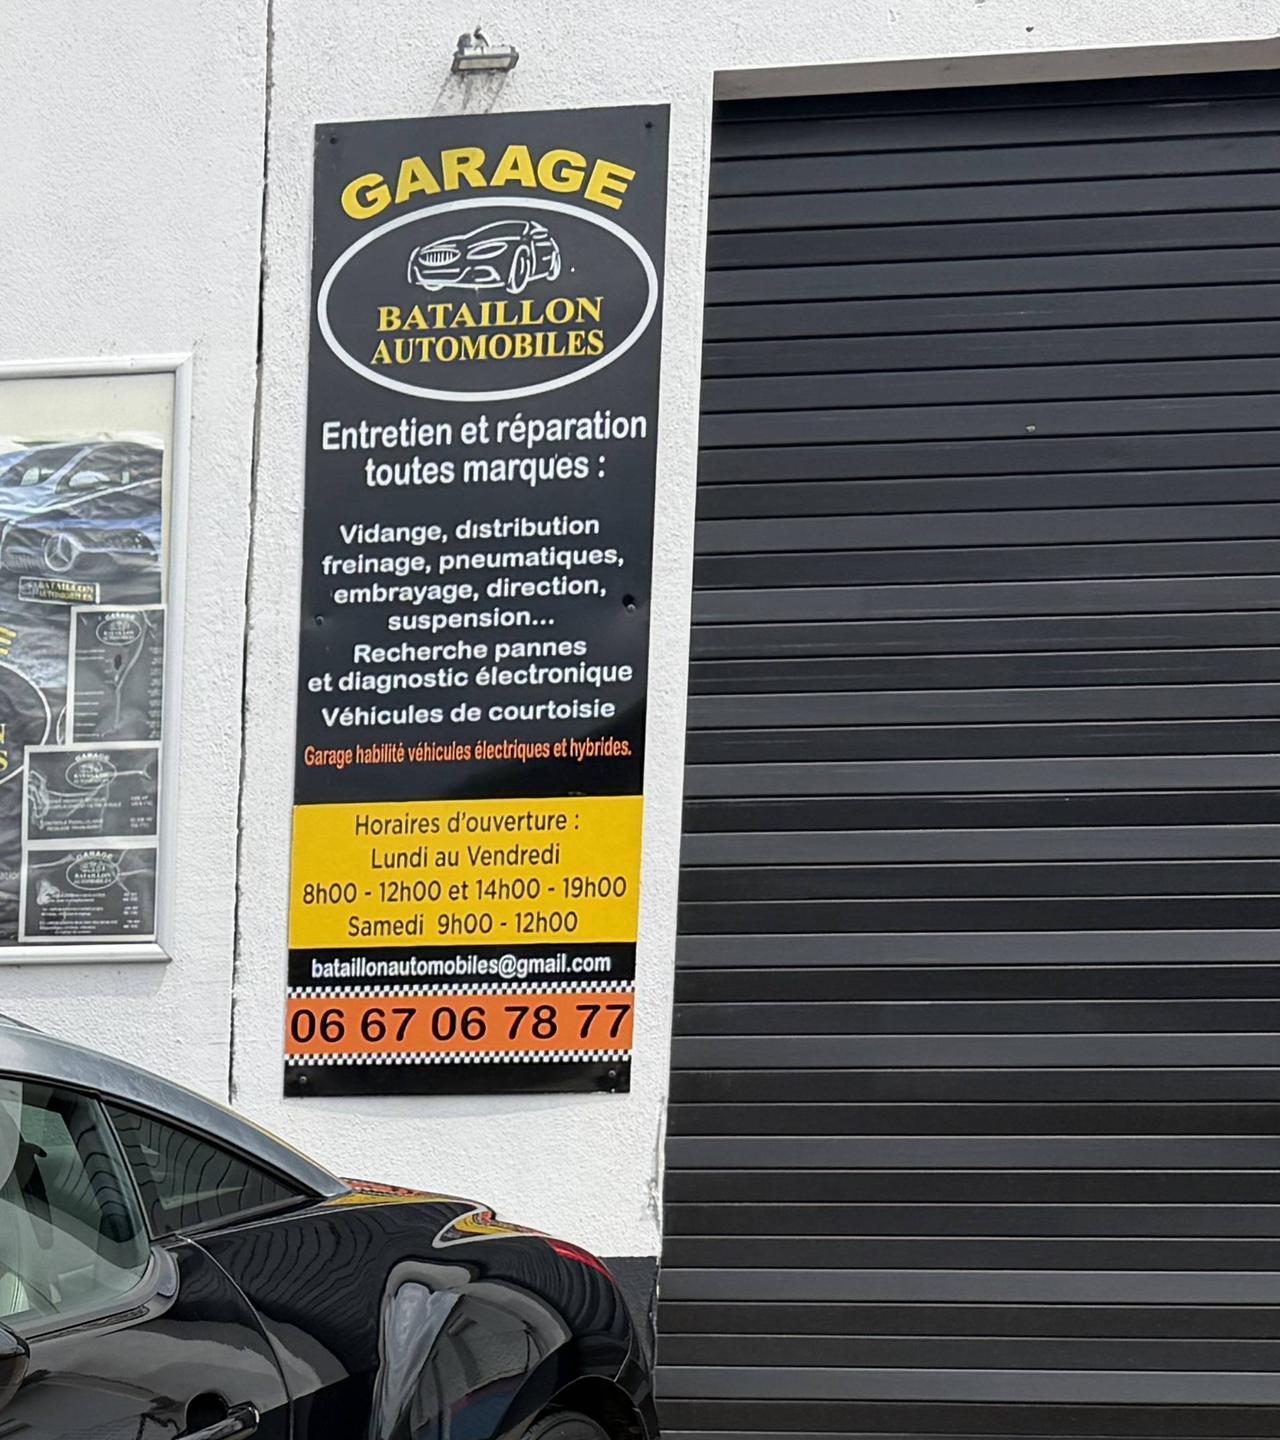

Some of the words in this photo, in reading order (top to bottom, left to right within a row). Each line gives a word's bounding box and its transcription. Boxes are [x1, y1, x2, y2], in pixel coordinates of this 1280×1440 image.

[341, 144, 636, 220] GARAGE
[377, 296, 605, 332] BATAILLON
[370, 329, 605, 365] AUTOMOBILES
[322, 419, 452, 451] Entretien
[461, 415, 489, 445] et
[497, 411, 647, 449] réparation
[365, 457, 454, 487] toutes
[464, 453, 589, 489] marques
[598, 455, 606, 477] :
[339, 523, 448, 546] Vidange,
[455, 516, 600, 541] distribution
[322, 554, 432, 577] freinage,
[439, 546, 625, 575] pneumatiques,
[333, 582, 479, 607] embrayage,
[486, 576, 607, 599] direction,
[387, 608, 555, 633] suspension...
[353, 640, 487, 664] Recherche
[495, 638, 588, 660] pannes
[307, 673, 333, 693] et
[338, 665, 469, 694] diagnostic
[475, 662, 633, 690] électronique
[321, 703, 443, 728] Véhicules
[450, 701, 482, 723] de
[488, 698, 616, 721] courtoisie
[304, 745, 353, 769] Garage
[356, 742, 405, 764] habilité
[408, 740, 471, 763] véhicules
[474, 738, 550, 762] électriques
[553, 738, 567, 757] et
[570, 736, 632, 763] hybrides.
[355, 813, 440, 837] Horaires
[371, 846, 428, 869] Lundi
[434, 850, 460, 867] au
[466, 843, 560, 866] Vendredi
[302, 882, 357, 905] 8h00
[379, 880, 441, 903] 12h00
[448, 882, 469, 901] et
[475, 877, 541, 900] 14h00
[562, 876, 627, 898] 19h00
[348, 914, 424, 937] Samedi
[437, 913, 493, 935] 9h00
[514, 911, 578, 933] 12h00
[311, 953, 611, 979] bataillonautomobiles@gmail.com
[290, 1007, 346, 1043] 06
[360, 1007, 417, 1042] 67
[431, 1006, 487, 1042] 06
[504, 1005, 558, 1041] 78
[575, 1004, 632, 1039] 77
